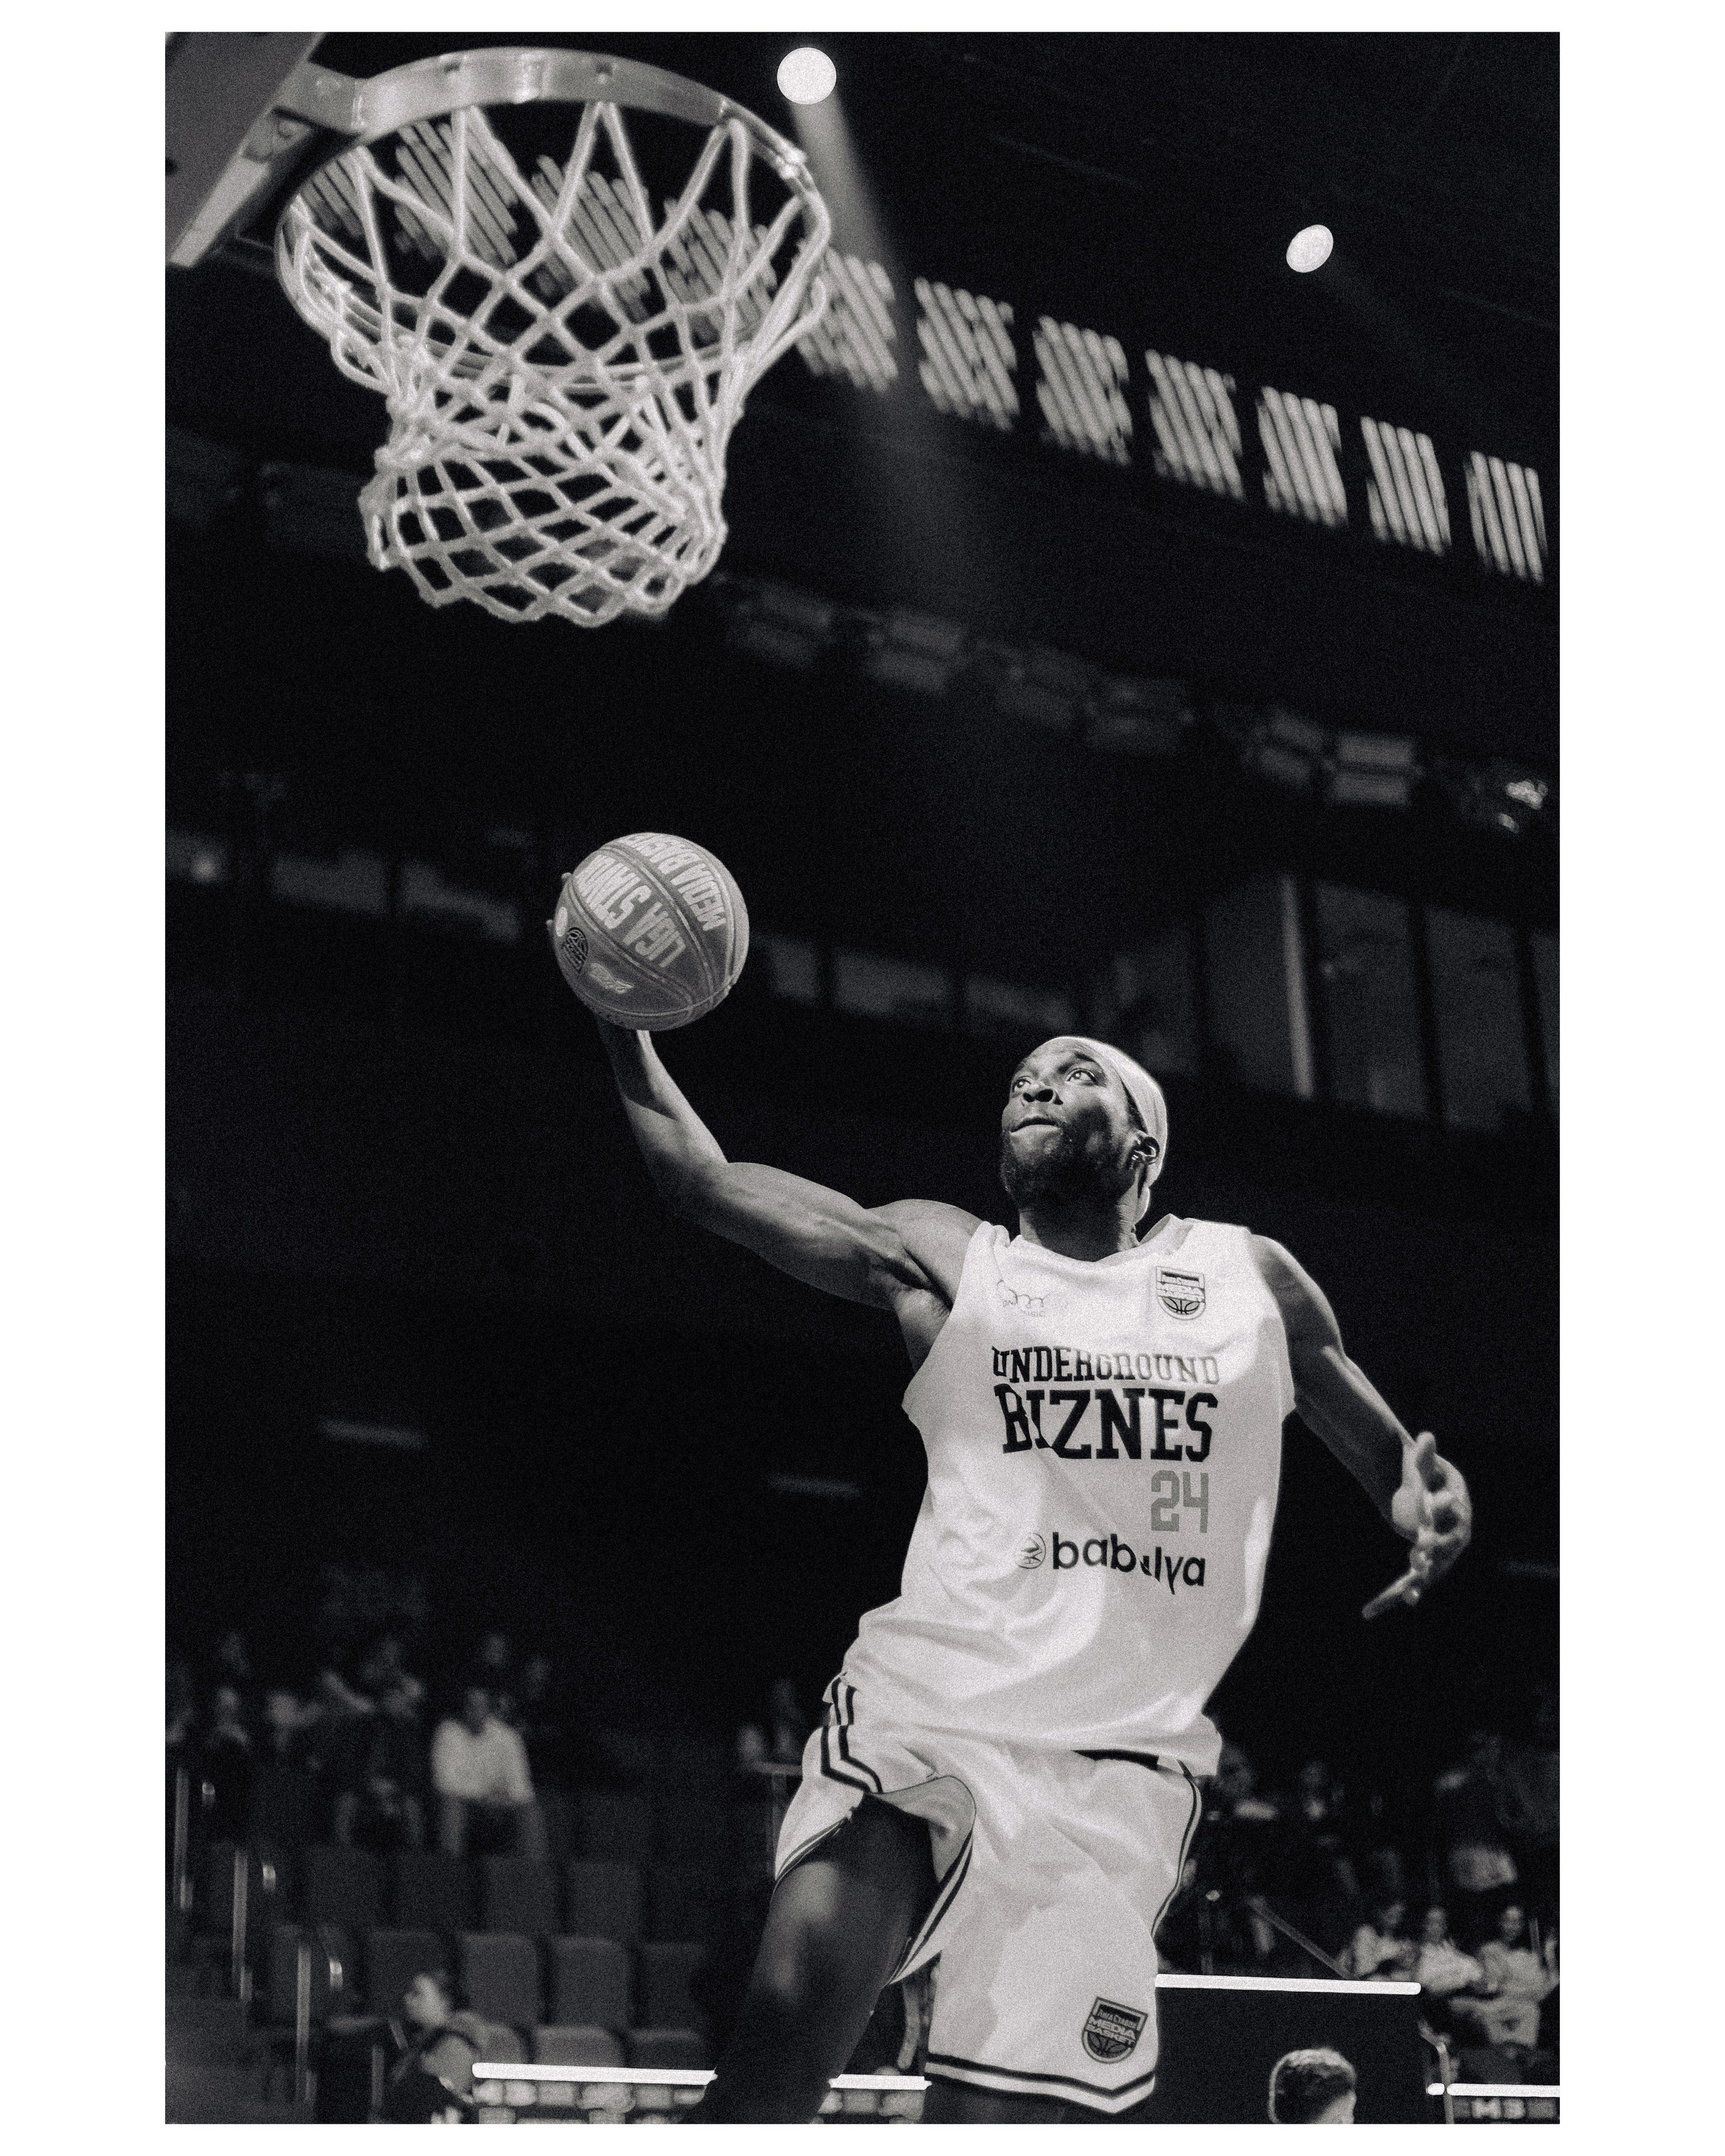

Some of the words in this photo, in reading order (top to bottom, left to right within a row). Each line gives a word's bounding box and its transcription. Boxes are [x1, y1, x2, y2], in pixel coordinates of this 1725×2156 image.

[669, 862, 726, 931] MEDIA
[621, 901, 686, 968] LIGA
[991, 1345, 1220, 1385] UNDERGROUND
[993, 1383, 1219, 1463] BIZNES
[1150, 1470, 1209, 1533] 24
